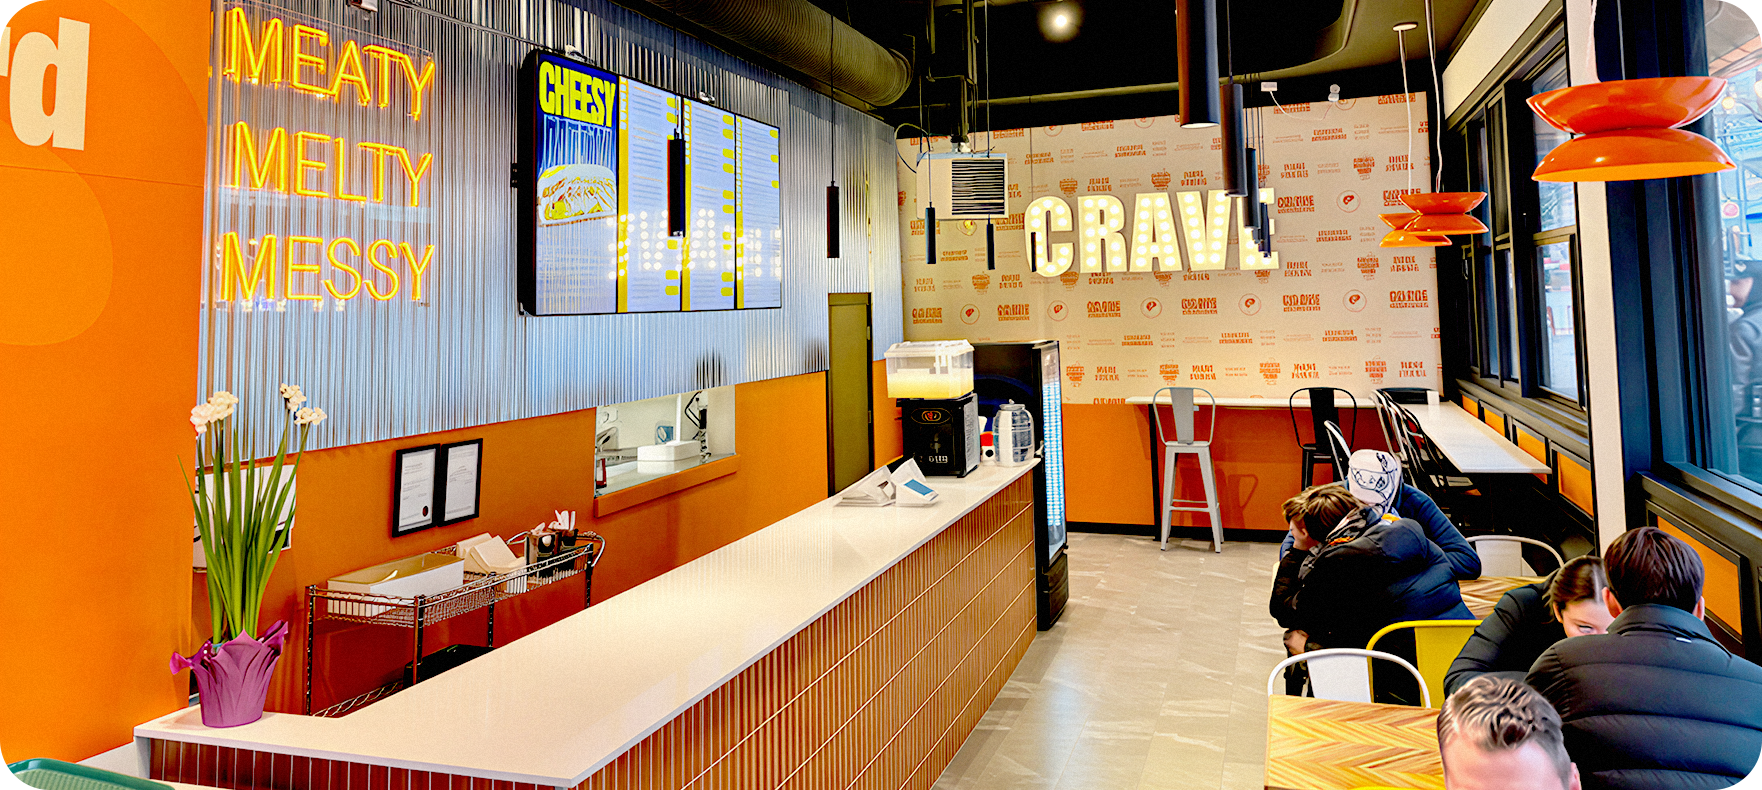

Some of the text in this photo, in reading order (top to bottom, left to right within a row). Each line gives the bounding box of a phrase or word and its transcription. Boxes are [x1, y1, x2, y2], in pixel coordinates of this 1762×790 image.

[224, 7, 435, 120] MEATY
[539, 61, 616, 127] CHEESY
[233, 120, 433, 207] MELTY
[221, 231, 435, 301] MESSY
